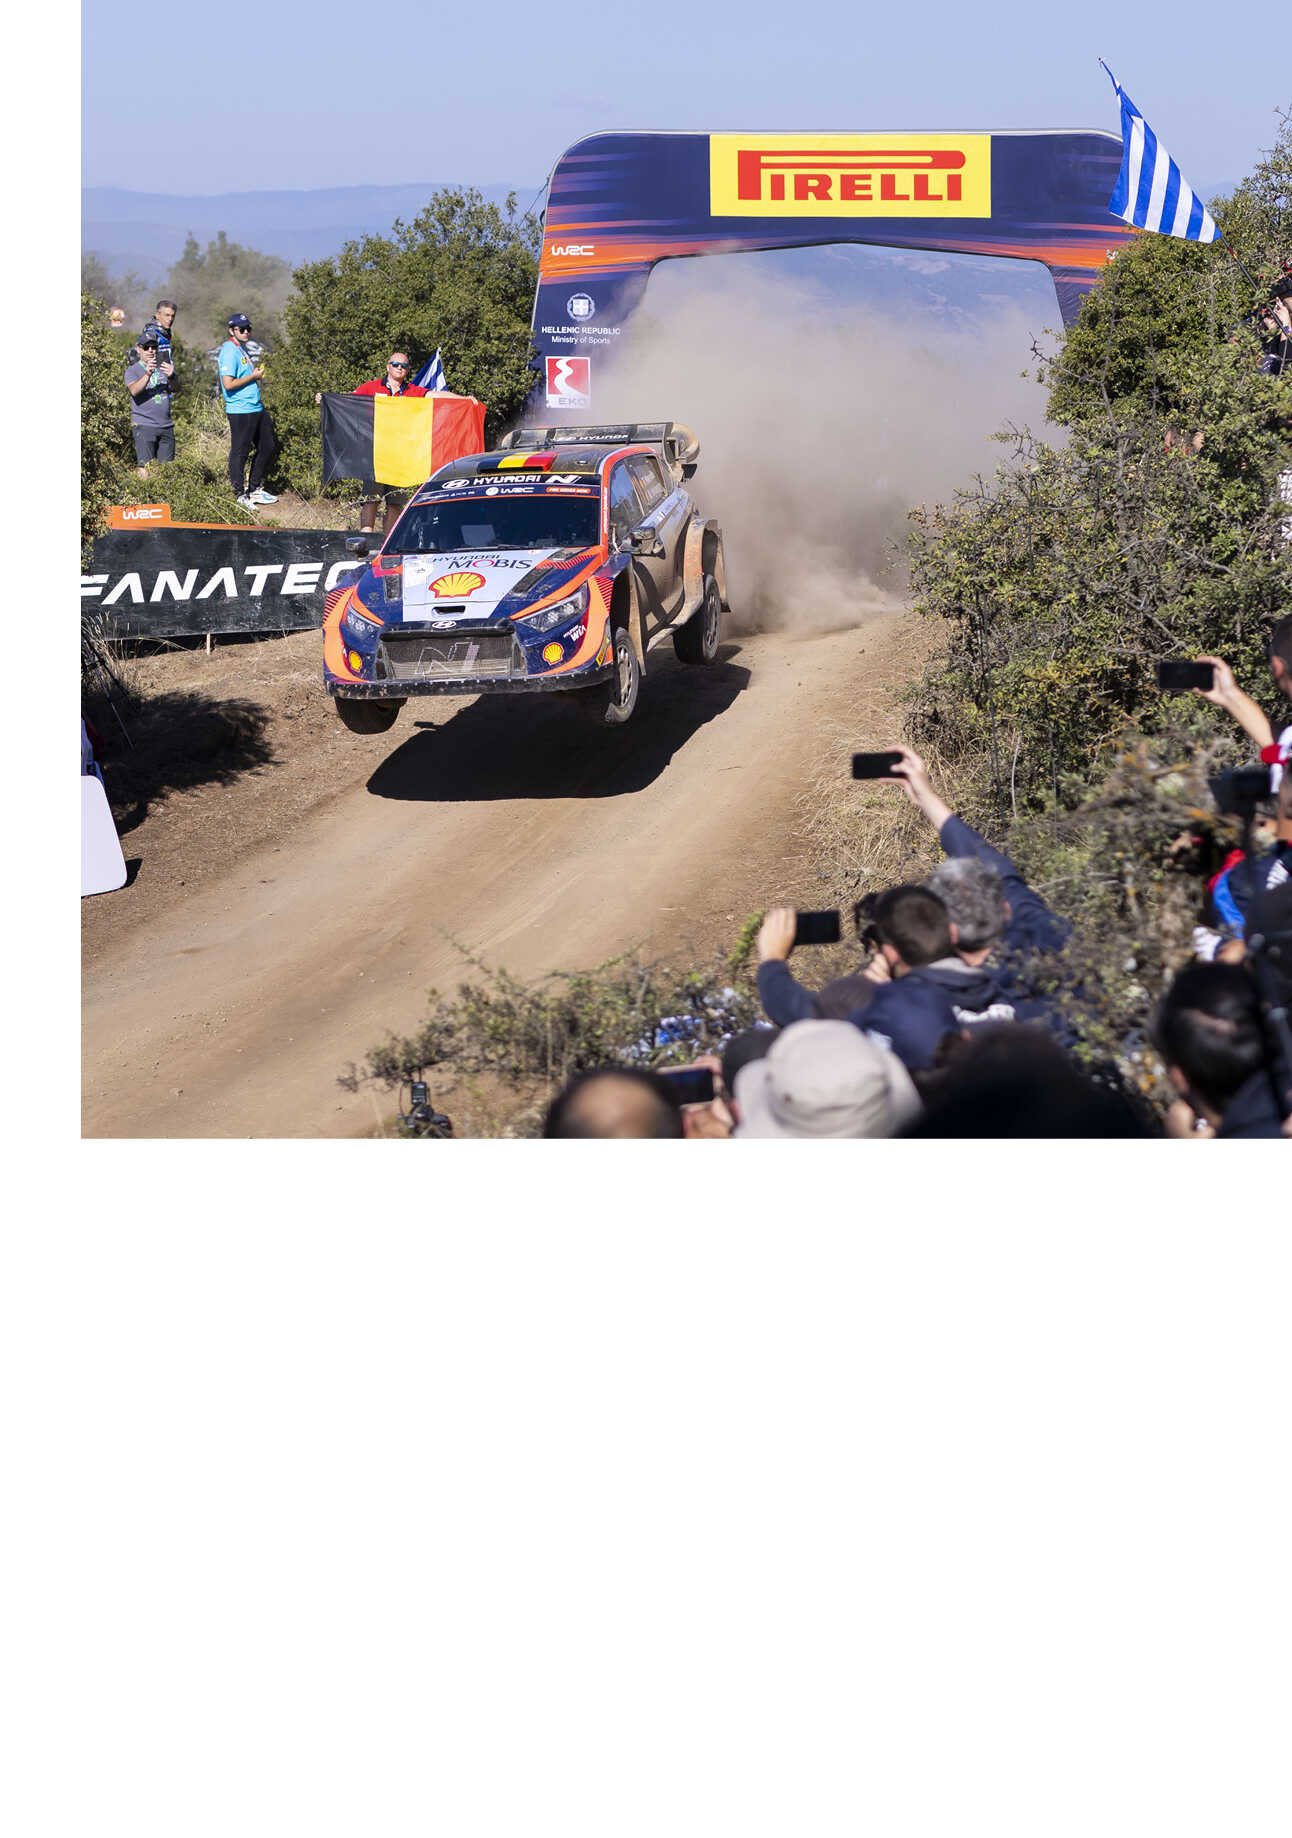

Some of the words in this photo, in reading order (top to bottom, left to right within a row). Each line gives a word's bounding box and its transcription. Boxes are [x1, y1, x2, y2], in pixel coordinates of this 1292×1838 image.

[737, 150, 966, 200] PIRELLI
[551, 245, 595, 256] WRC
[541, 326, 580, 334] HELLENIC
[581, 326, 621, 335] REPUBLIC
[551, 335, 578, 345] Ministry
[579, 336, 588, 344] of
[588, 336, 611, 346] Sports
[473, 474, 542, 486] HYUNDAI
[122, 508, 164, 520] WRC
[432, 554, 501, 563] HYUNDAI
[448, 559, 532, 569] MOBIS
